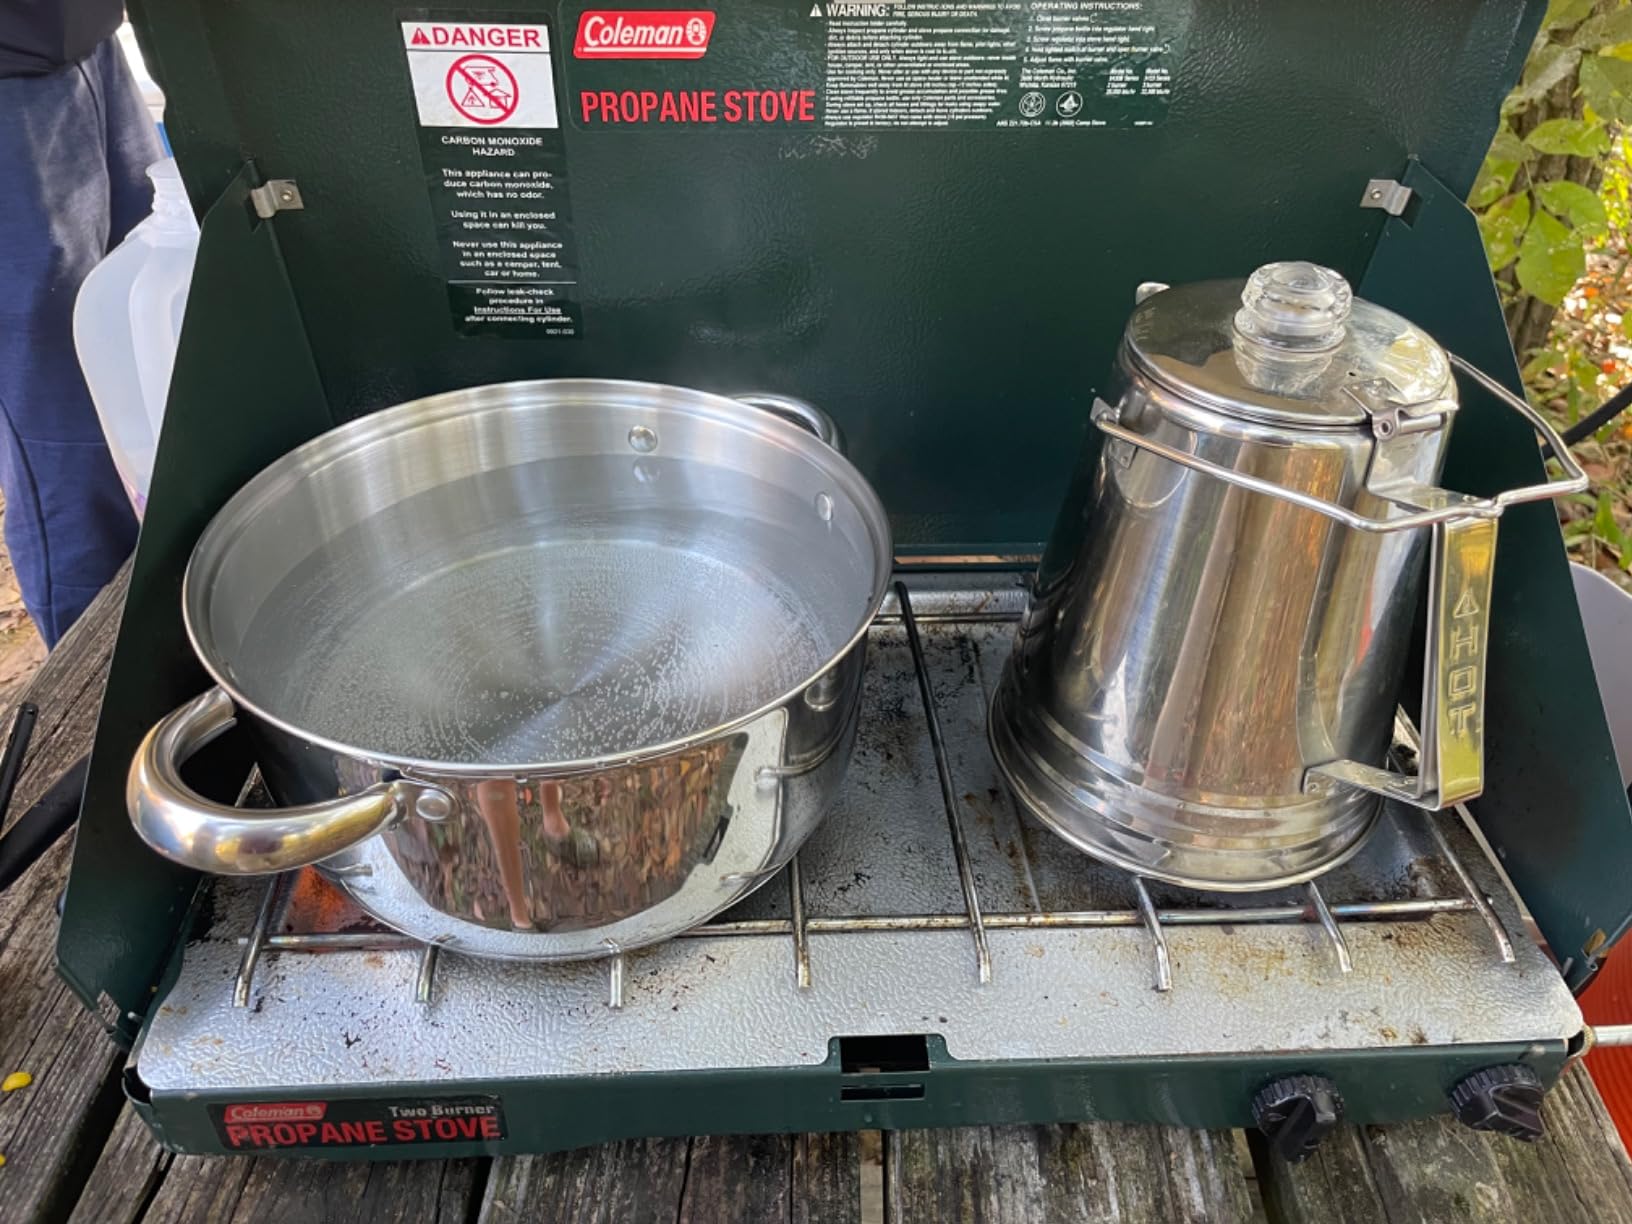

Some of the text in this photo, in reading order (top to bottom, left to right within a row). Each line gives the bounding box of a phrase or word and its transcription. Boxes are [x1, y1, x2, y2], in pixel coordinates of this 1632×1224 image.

[826, 4, 890, 16] WARNING:
[432, 25, 541, 48] DANGER
[584, 15, 682, 48] Coleman
[581, 89, 816, 122] PROPANE STOVE
[442, 136, 541, 145] CARBON MONOXIDE
[473, 148, 514, 156] HAZARD
[443, 169, 462, 177] This
[451, 211, 478, 219] Using
[1448, 627, 1478, 733] HOT
[229, 1106, 304, 1119] Coleman
[389, 1104, 494, 1118] Two Burner
[225, 1116, 501, 1147] PROPANE STOVE
